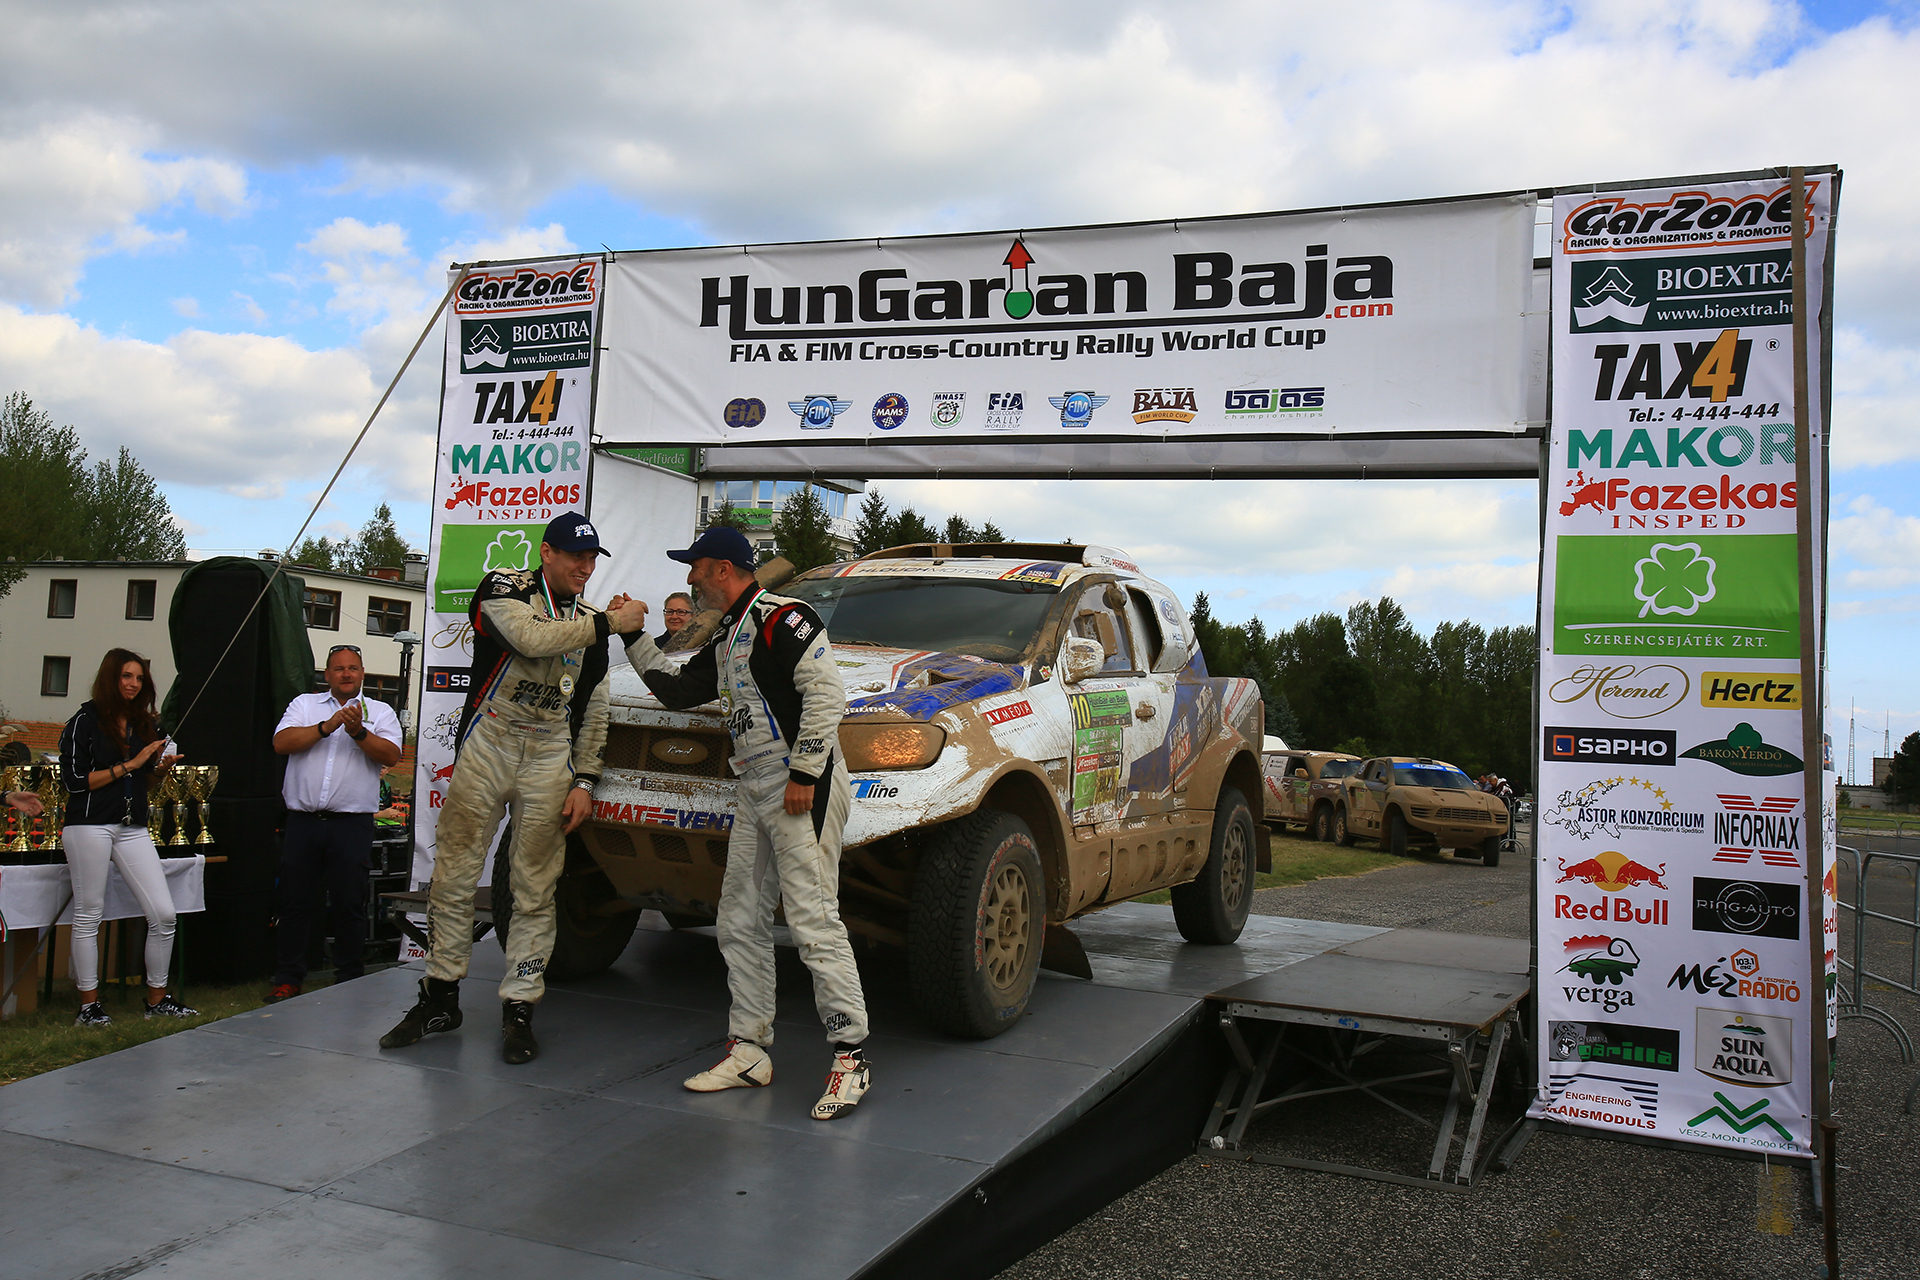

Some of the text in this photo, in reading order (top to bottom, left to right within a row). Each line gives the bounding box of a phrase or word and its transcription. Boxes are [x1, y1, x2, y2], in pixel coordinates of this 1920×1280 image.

[1570, 224, 1792, 248] RACING & ORGANIZATIONS & PROMOTIO
[1172, 244, 1394, 318] Baja
[459, 302, 484, 310] RACING
[486, 301, 491, 309] &
[493, 299, 543, 308] ORGANIZATIONS
[551, 294, 592, 303] PROMOTIONS
[1326, 302, 1393, 320] .com
[513, 320, 590, 342] BIOEXTRA
[730, 326, 1326, 362] FIA & FIM Cross-Country Rally World Cup
[513, 349, 589, 364] www.bioextra.hu
[1068, 400, 1088, 413] FIM
[1131, 390, 1198, 413] BAJA
[1225, 387, 1325, 412] bajas
[808, 406, 830, 420] FIM
[876, 408, 904, 416] MAMS
[987, 416, 1021, 424] RALLY
[1224, 412, 1323, 420] championships
[1628, 402, 1780, 423] Tel.: 4-444-444
[492, 426, 574, 440] Tel.: 4-444-444
[1567, 422, 1796, 469] MAKOR
[451, 441, 581, 475] MAKOR
[476, 479, 580, 508] Fazekas
[1606, 474, 1798, 511] Fazekas
[477, 507, 552, 520] INSPED
[1611, 513, 1746, 529] INSPED
[797, 622, 811, 639] OMP
[1549, 664, 1690, 719] Herend
[1709, 678, 1795, 703] Hertz
[1072, 695, 1090, 729] 10
[1578, 808, 1705, 828] ASTOR KONZORCIUM
[1651, 825, 1674, 833] Transport
[1714, 812, 1800, 850] INFORNAX
[1555, 894, 1669, 926] Red Bull
[516, 957, 544, 971] SOUTH
[1735, 958, 1754, 966] 103.1
[1562, 986, 1635, 1014] verga
[1738, 976, 1801, 1003] RÁDIÓ
[1720, 1037, 1765, 1057] SUN
[1712, 1053, 1775, 1077] AQUA
[1565, 1091, 1632, 1107] ENGINEERING
[1544, 1104, 1656, 1130] ANSMODULS
[1678, 1128, 1747, 1146] VESZ-MONT
[1750, 1136, 1777, 1149] 2000
